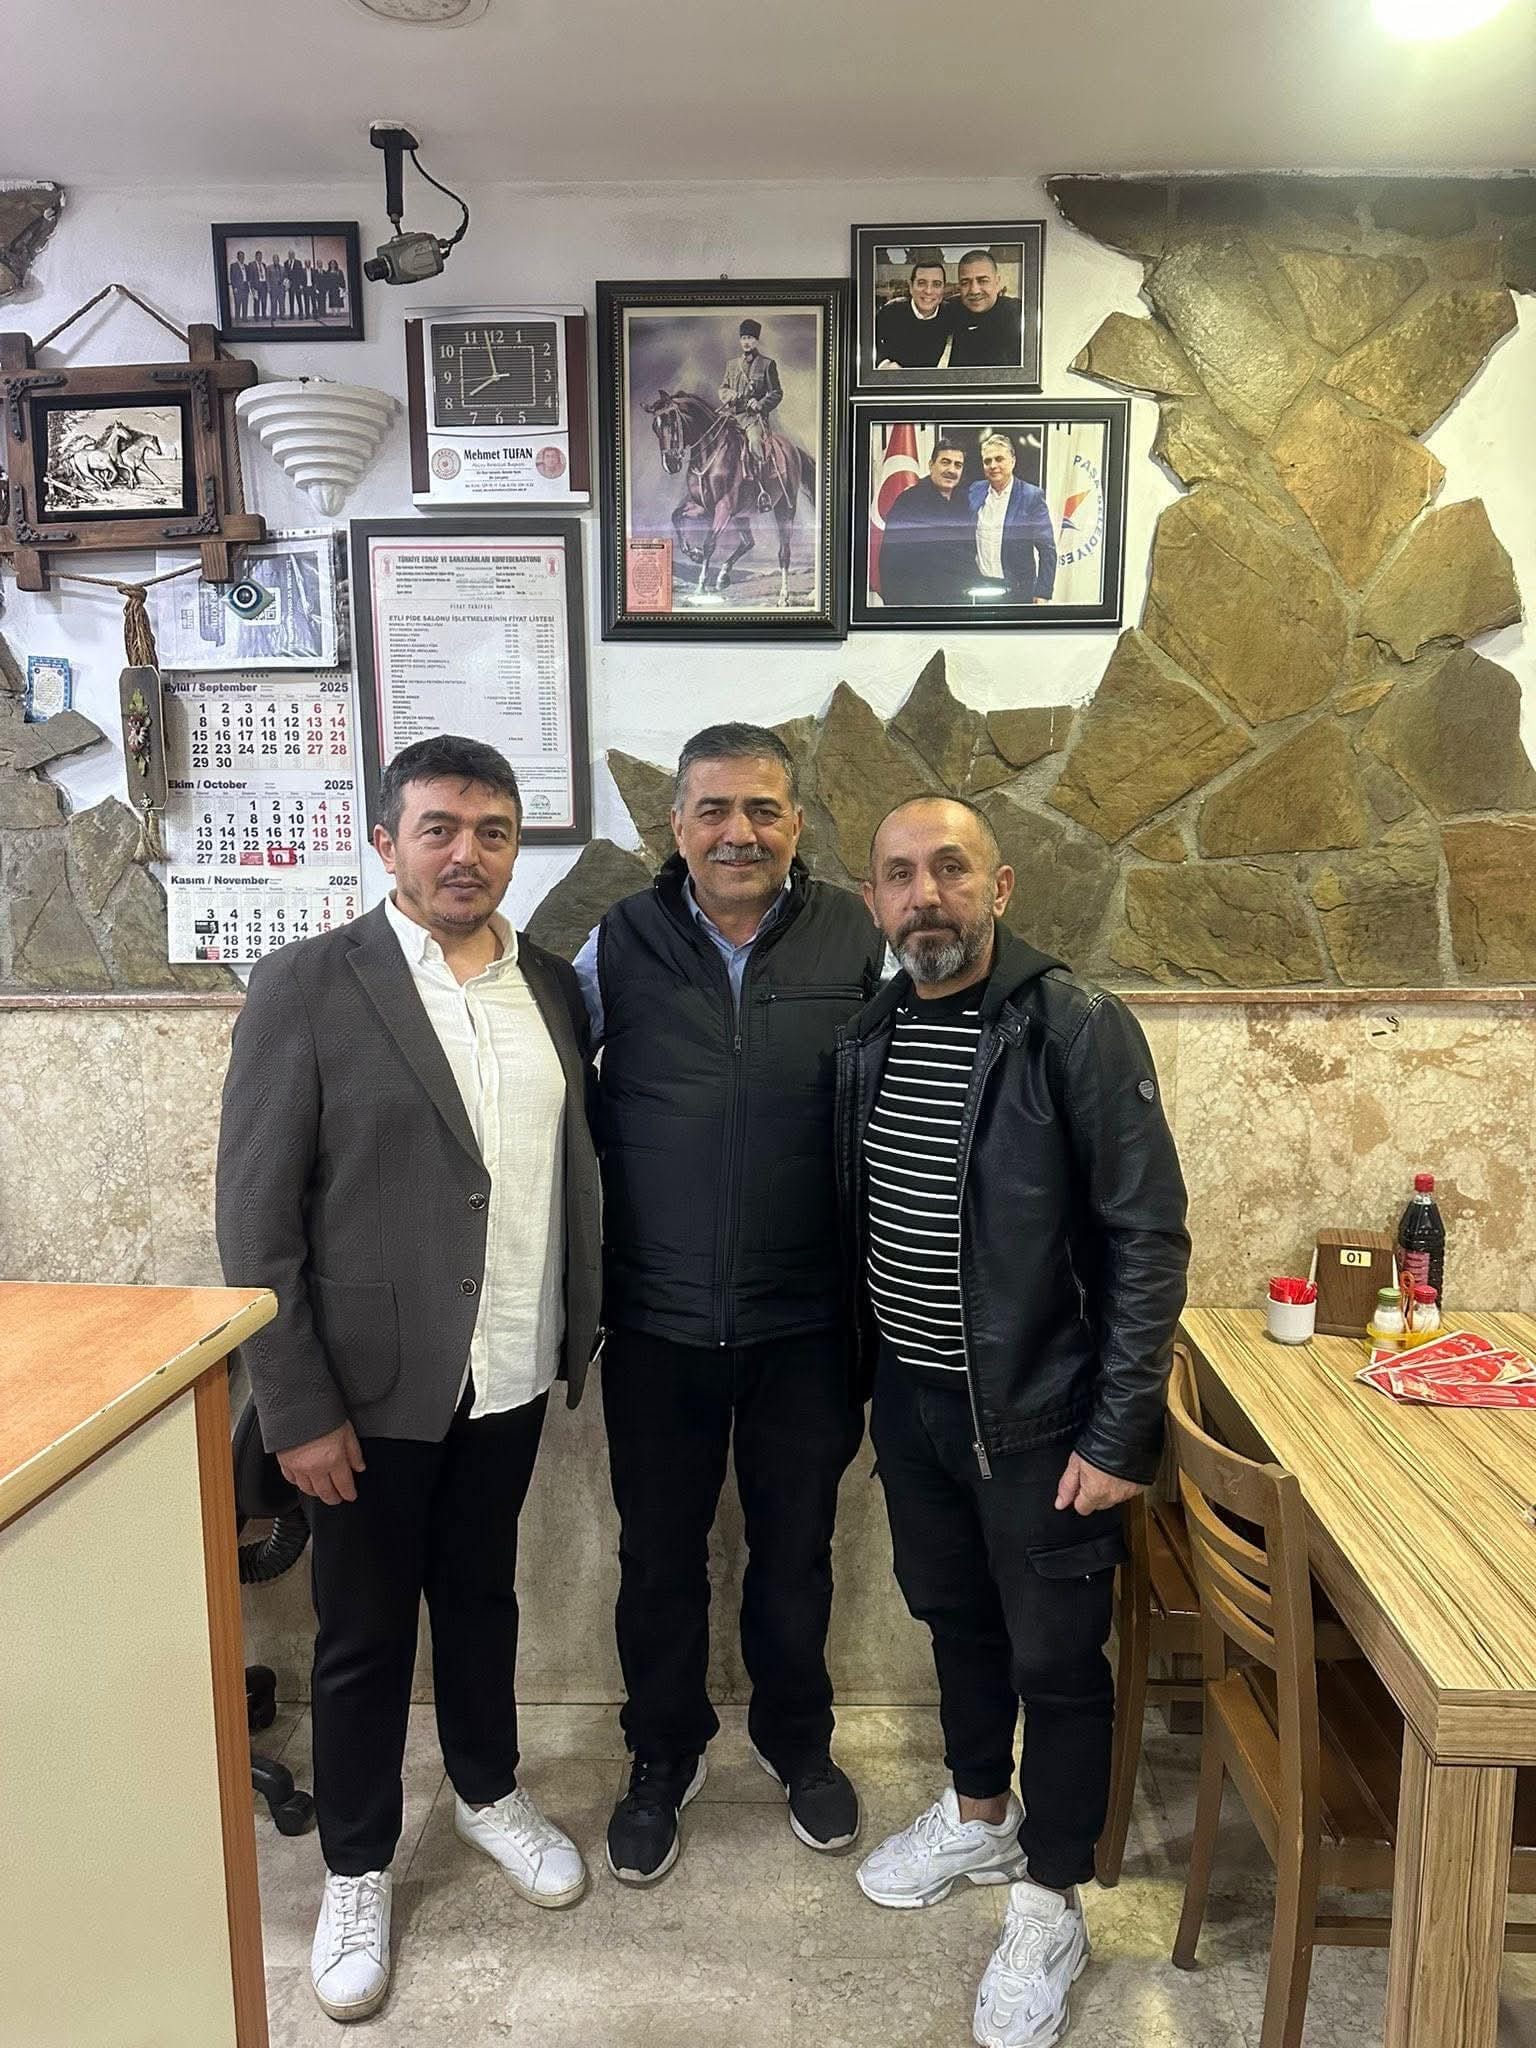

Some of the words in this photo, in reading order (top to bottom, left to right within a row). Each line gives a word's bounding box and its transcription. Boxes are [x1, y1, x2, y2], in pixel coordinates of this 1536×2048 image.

[464, 330, 477, 344] 11
[490, 330, 504, 344] 12
[515, 330, 522, 343] 1
[440, 344, 454, 358] 10
[543, 343, 551, 356] 2
[443, 371, 452, 384] 9
[543, 370, 552, 383] 3
[444, 397, 453, 409] 8
[544, 396, 553, 408] 4
[469, 412, 478, 424] 7
[495, 411, 504, 424] 6
[518, 411, 526, 424] 5
[464, 448, 500, 460] Mehmet
[502, 447, 533, 459] TUFAN
[397, 555, 420, 564] TÜRKİYE
[421, 555, 439, 563] ESNAF
[440, 555, 448, 563] VE
[491, 555, 541, 564] KONFEDERASYONU
[452, 615, 507, 623] İŞLETMELERİNİN
[199, 683, 258, 694] September
[319, 682, 349, 692] 2025
[199, 702, 206, 714] 1
[221, 702, 230, 714] 2
[244, 702, 253, 714] 3
[267, 702, 276, 714] 4
[291, 703, 299, 714] 5
[313, 703, 322, 714] 6
[336, 703, 345, 715] 7
[199, 716, 208, 728] 8
[221, 716, 231, 728] 9
[237, 716, 253, 728] 10
[260, 716, 275, 728] 11
[283, 716, 300, 728] 12
[306, 716, 323, 728] 13
[329, 716, 346, 728] 14
[191, 729, 208, 741] 15
[214, 729, 231, 741] 16
[237, 729, 254, 741] 17
[260, 730, 277, 742] 18
[284, 730, 300, 742] 19
[306, 730, 324, 742] 20
[329, 730, 345, 742] 21
[192, 743, 209, 755] 22
[215, 743, 232, 755] 23
[238, 743, 255, 755] 24
[261, 743, 278, 755] 25
[284, 743, 301, 755] 26
[307, 743, 324, 755] 27
[330, 744, 347, 756] 28
[192, 757, 209, 768] 29
[215, 756, 232, 768] 30
[167, 780, 194, 789] Ekim
[203, 779, 248, 789] October
[324, 780, 354, 790] 2025
[249, 800, 256, 811] 1
[272, 800, 281, 811] 2
[295, 800, 304, 811] 3
[318, 800, 328, 812] 4
[342, 800, 351, 812] 5
[203, 813, 212, 825] 6
[226, 813, 235, 824] 7
[249, 813, 258, 825] 8
[272, 813, 281, 825] 9
[288, 813, 305, 825] 10
[311, 813, 327, 825] 11
[334, 814, 351, 825] 12
[196, 826, 213, 838] 13
[219, 826, 236, 838] 14
[242, 826, 259, 838] 15
[265, 826, 282, 838] 16
[289, 827, 305, 838] 17
[312, 827, 329, 839] 18
[335, 827, 352, 839] 19
[196, 839, 213, 851] 20
[219, 839, 235, 851] 21
[242, 840, 260, 851] 22
[290, 840, 305, 850] 24
[312, 840, 329, 852] 25
[335, 840, 353, 852] 26
[196, 853, 213, 864] 27
[220, 853, 237, 865] 28
[170, 876, 205, 885] Kasım
[214, 876, 269, 885] November
[329, 876, 358, 886] 2025
[322, 895, 330, 907] 1
[345, 895, 354, 907] 2
[206, 908, 215, 920] 3
[229, 908, 239, 919] 4
[253, 908, 262, 920] 5
[276, 908, 286, 920] 6
[299, 909, 308, 920] 7
[322, 909, 331, 920] 8
[345, 909, 355, 920] 9
[222, 921, 237, 933] 11
[245, 921, 262, 933] 12
[269, 921, 286, 933] 13
[292, 922, 309, 933] 14
[199, 935, 216, 946] 17
[223, 935, 239, 946] 18
[245, 934, 262, 946] 19
[268, 935, 286, 946] 20
[223, 948, 239, 959] 25
[246, 948, 263, 959] 26
[1346, 1252, 1362, 1264] 01
